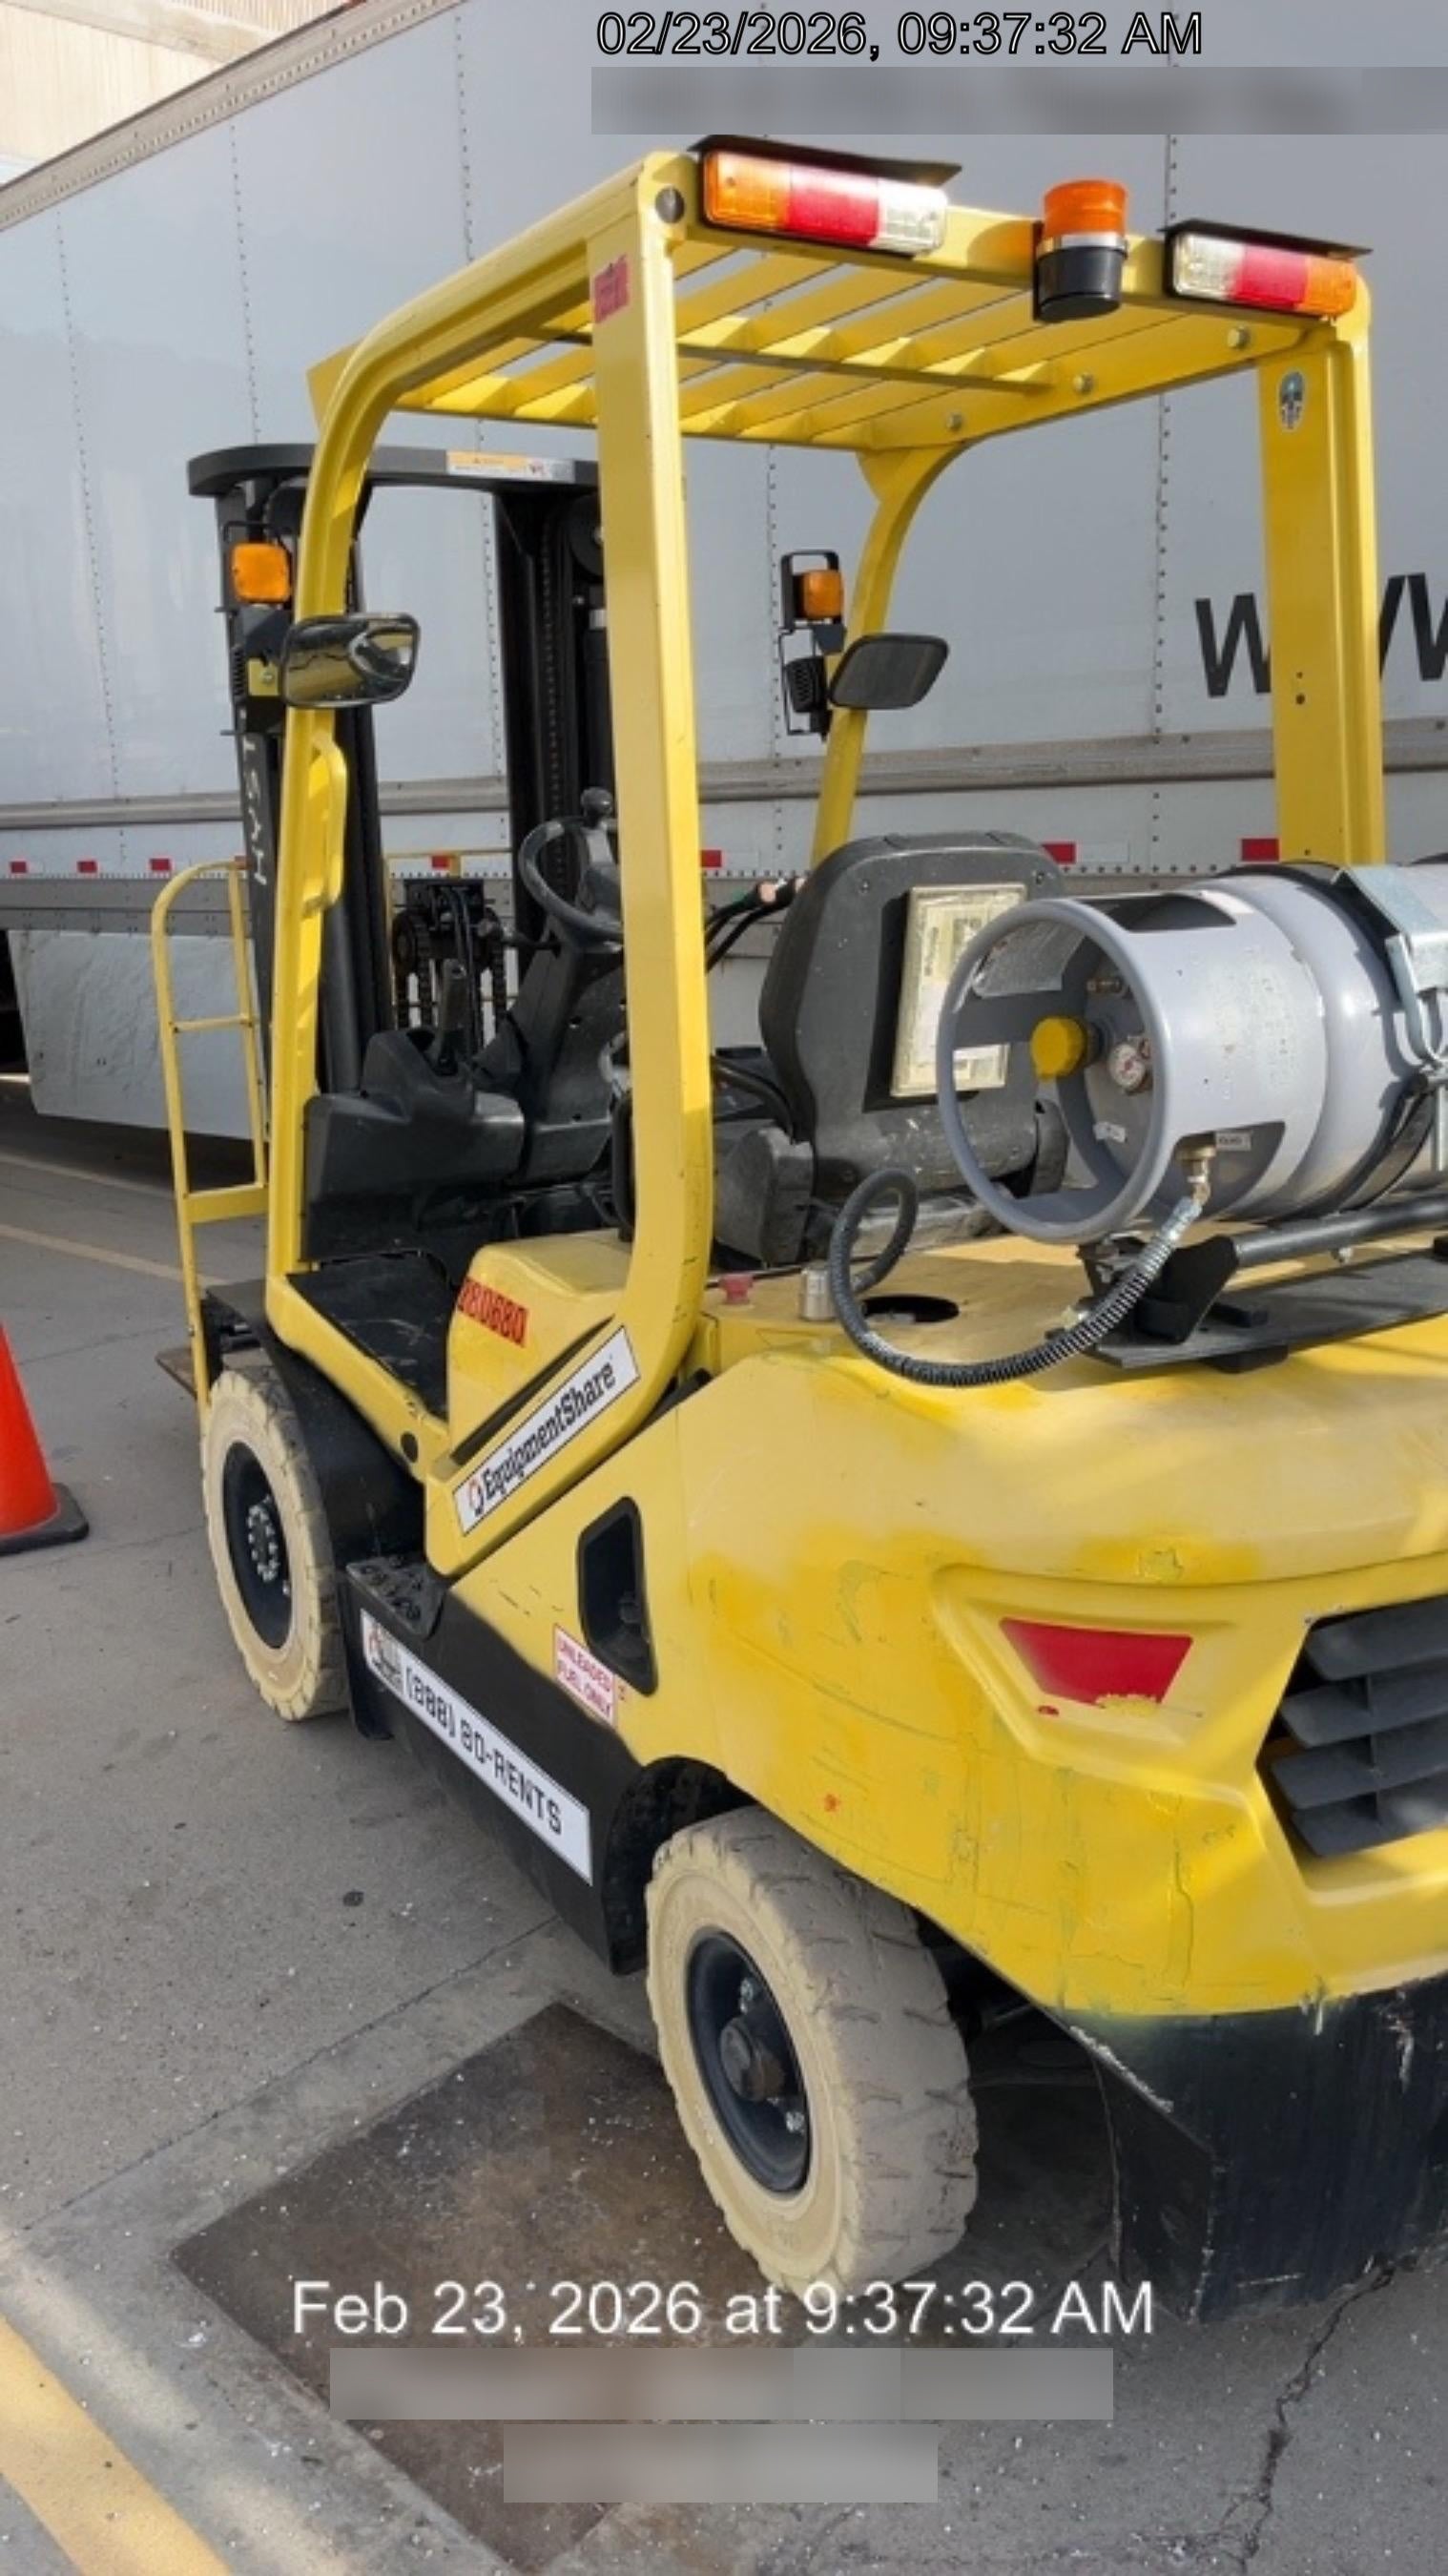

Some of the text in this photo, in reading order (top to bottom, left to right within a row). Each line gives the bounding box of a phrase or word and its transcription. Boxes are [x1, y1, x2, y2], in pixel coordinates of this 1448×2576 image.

[240, 708, 267, 884] HYST
[482, 1361, 616, 1501] EquipmentShare
[460, 1719, 562, 1836] 80-RENTS
